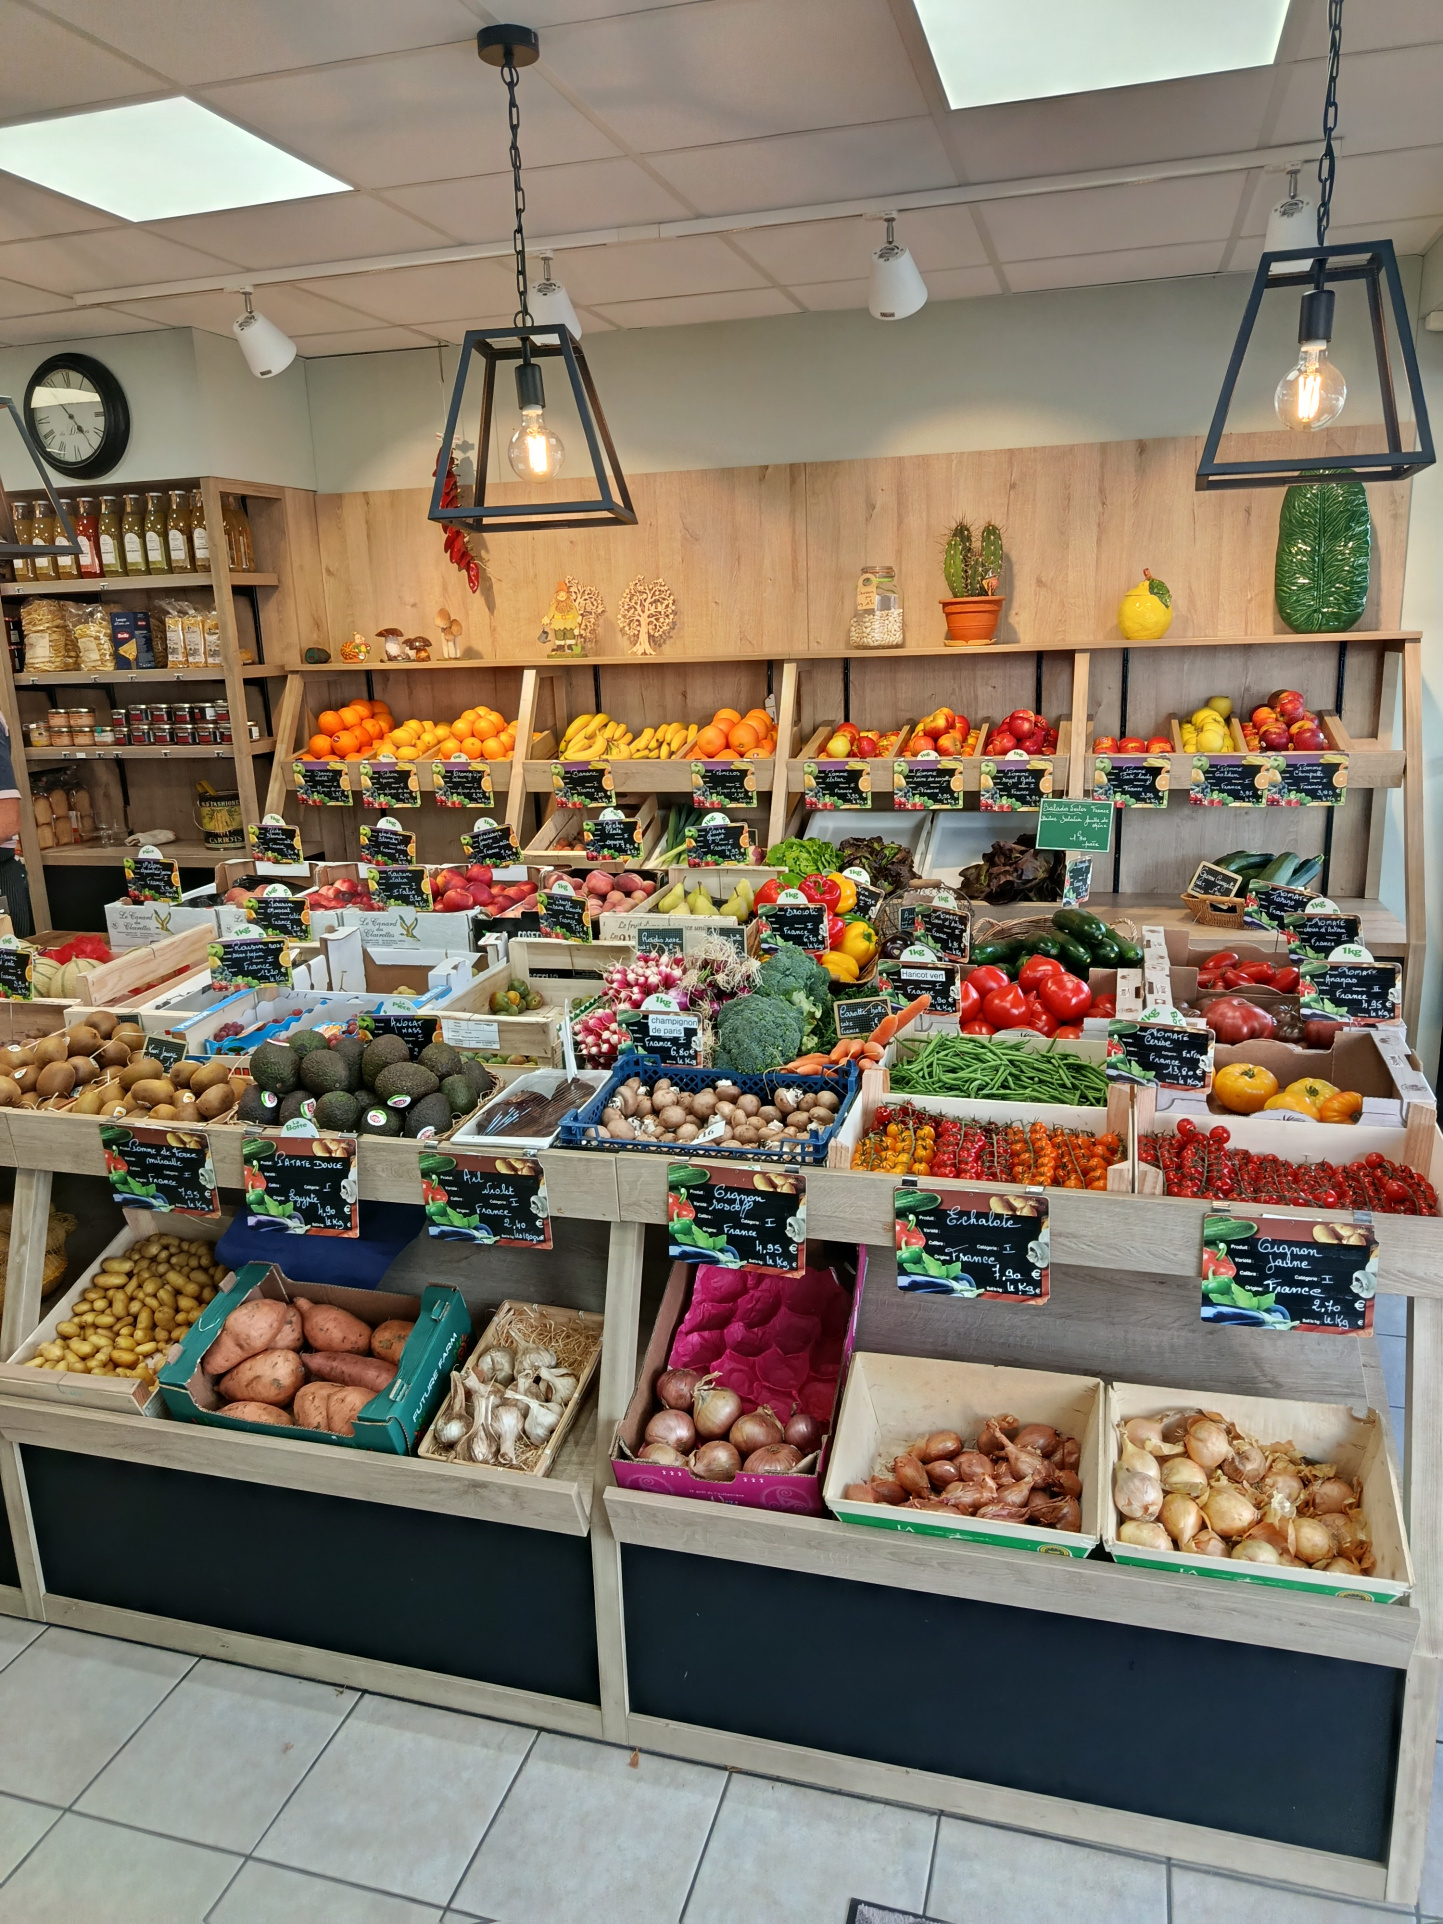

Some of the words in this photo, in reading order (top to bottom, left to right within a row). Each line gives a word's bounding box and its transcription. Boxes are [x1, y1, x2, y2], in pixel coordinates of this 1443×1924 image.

[1342, 947, 1362, 957] 1kg
[902, 970, 927, 979] Haricot
[907, 985, 935, 995] France
[1336, 989, 1368, 1000] France
[656, 996, 672, 1008] 1kg
[651, 1016, 697, 1027] champignon
[663, 1029, 682, 1037] paris
[645, 1037, 673, 1047] France
[1144, 1036, 1173, 1047] Cerise
[1149, 1053, 1180, 1065] France
[314, 1161, 343, 1169] DOUCE
[148, 1174, 178, 1186] France
[463, 1169, 484, 1184] Ail
[482, 1183, 515, 1195] Violet
[475, 1204, 512, 1216] France
[709, 1199, 754, 1218] roscoff
[504, 1219, 526, 1229] 2,40
[723, 1224, 757, 1237] France
[756, 1240, 782, 1254] 4,95
[945, 1244, 999, 1264] France
[992, 1264, 1021, 1281] 7,90
[1264, 1279, 1325, 1297] France
[1312, 1300, 1341, 1313] 2,70
[438, 1332, 458, 1369] FARM
